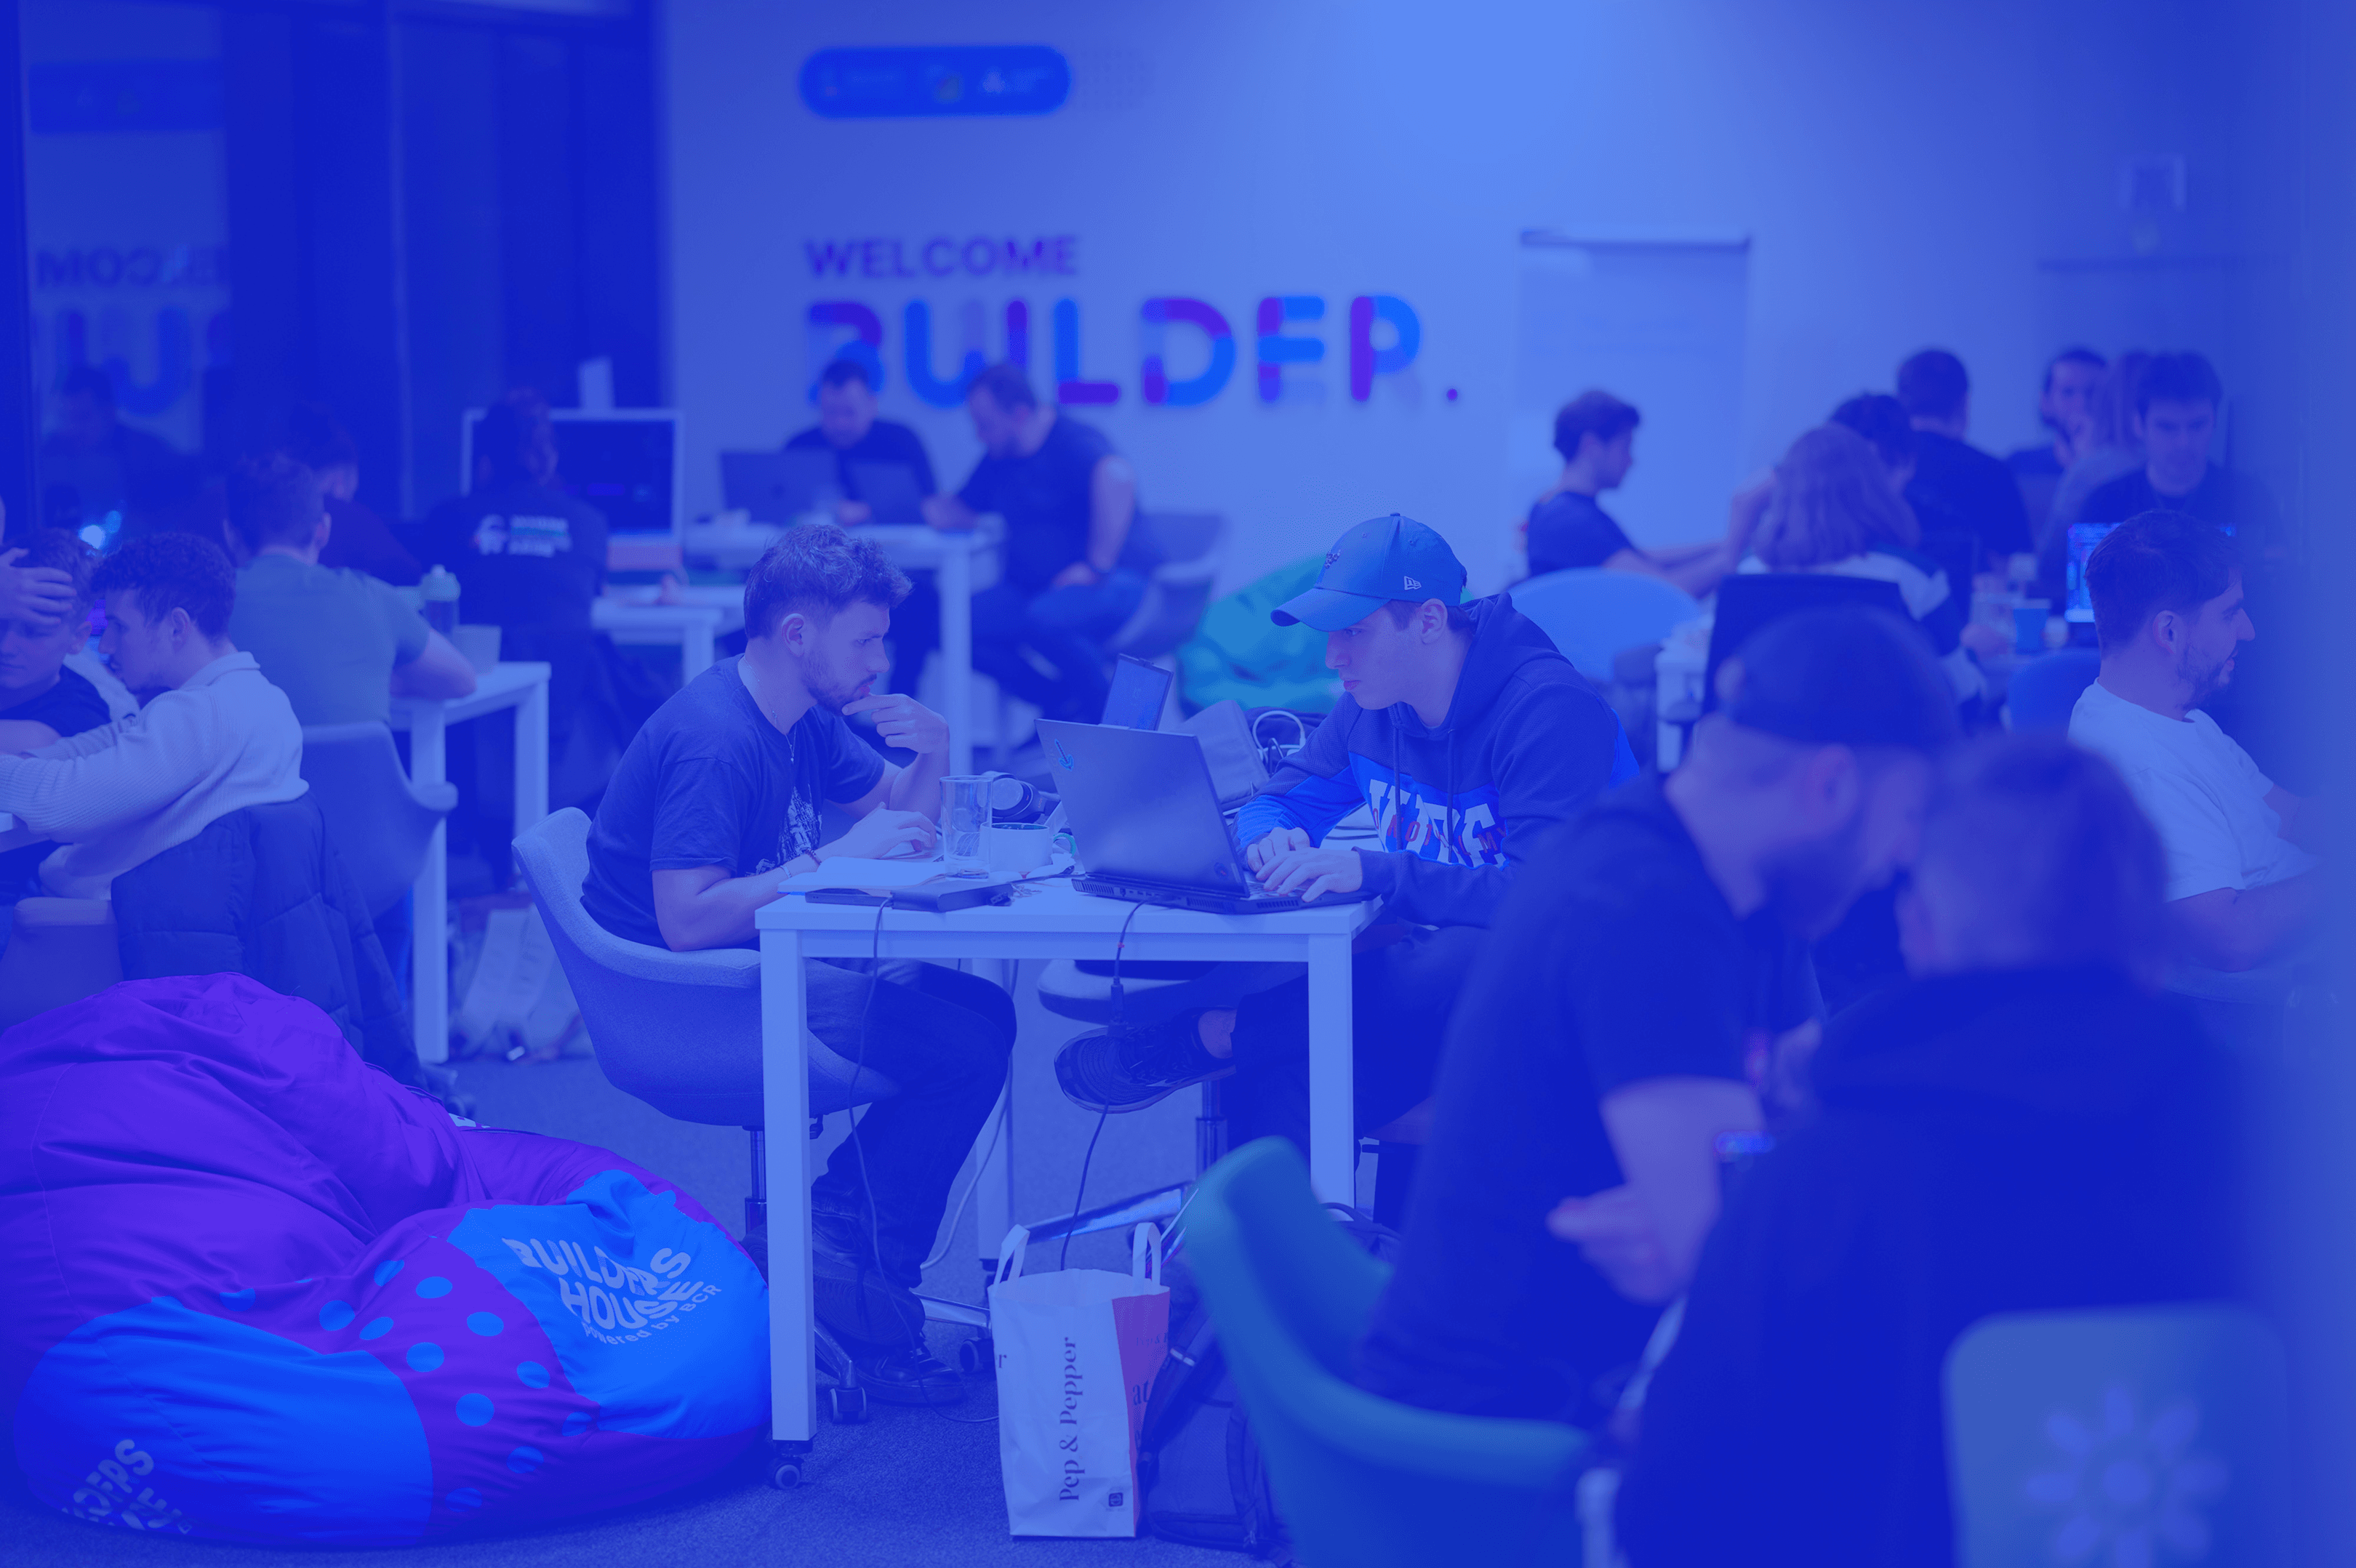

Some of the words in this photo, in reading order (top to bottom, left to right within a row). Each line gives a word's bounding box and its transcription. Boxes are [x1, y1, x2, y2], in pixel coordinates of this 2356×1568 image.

[804, 235, 1078, 278] WELCOME
[558, 1276, 705, 1330] HOUSE
[580, 1319, 653, 1346] powered
[650, 1314, 681, 1330] by
[678, 1284, 724, 1311] BCR
[1059, 1336, 1083, 1425] Pepper
[1059, 1434, 1078, 1452] &
[1059, 1459, 1086, 1501] Pep
